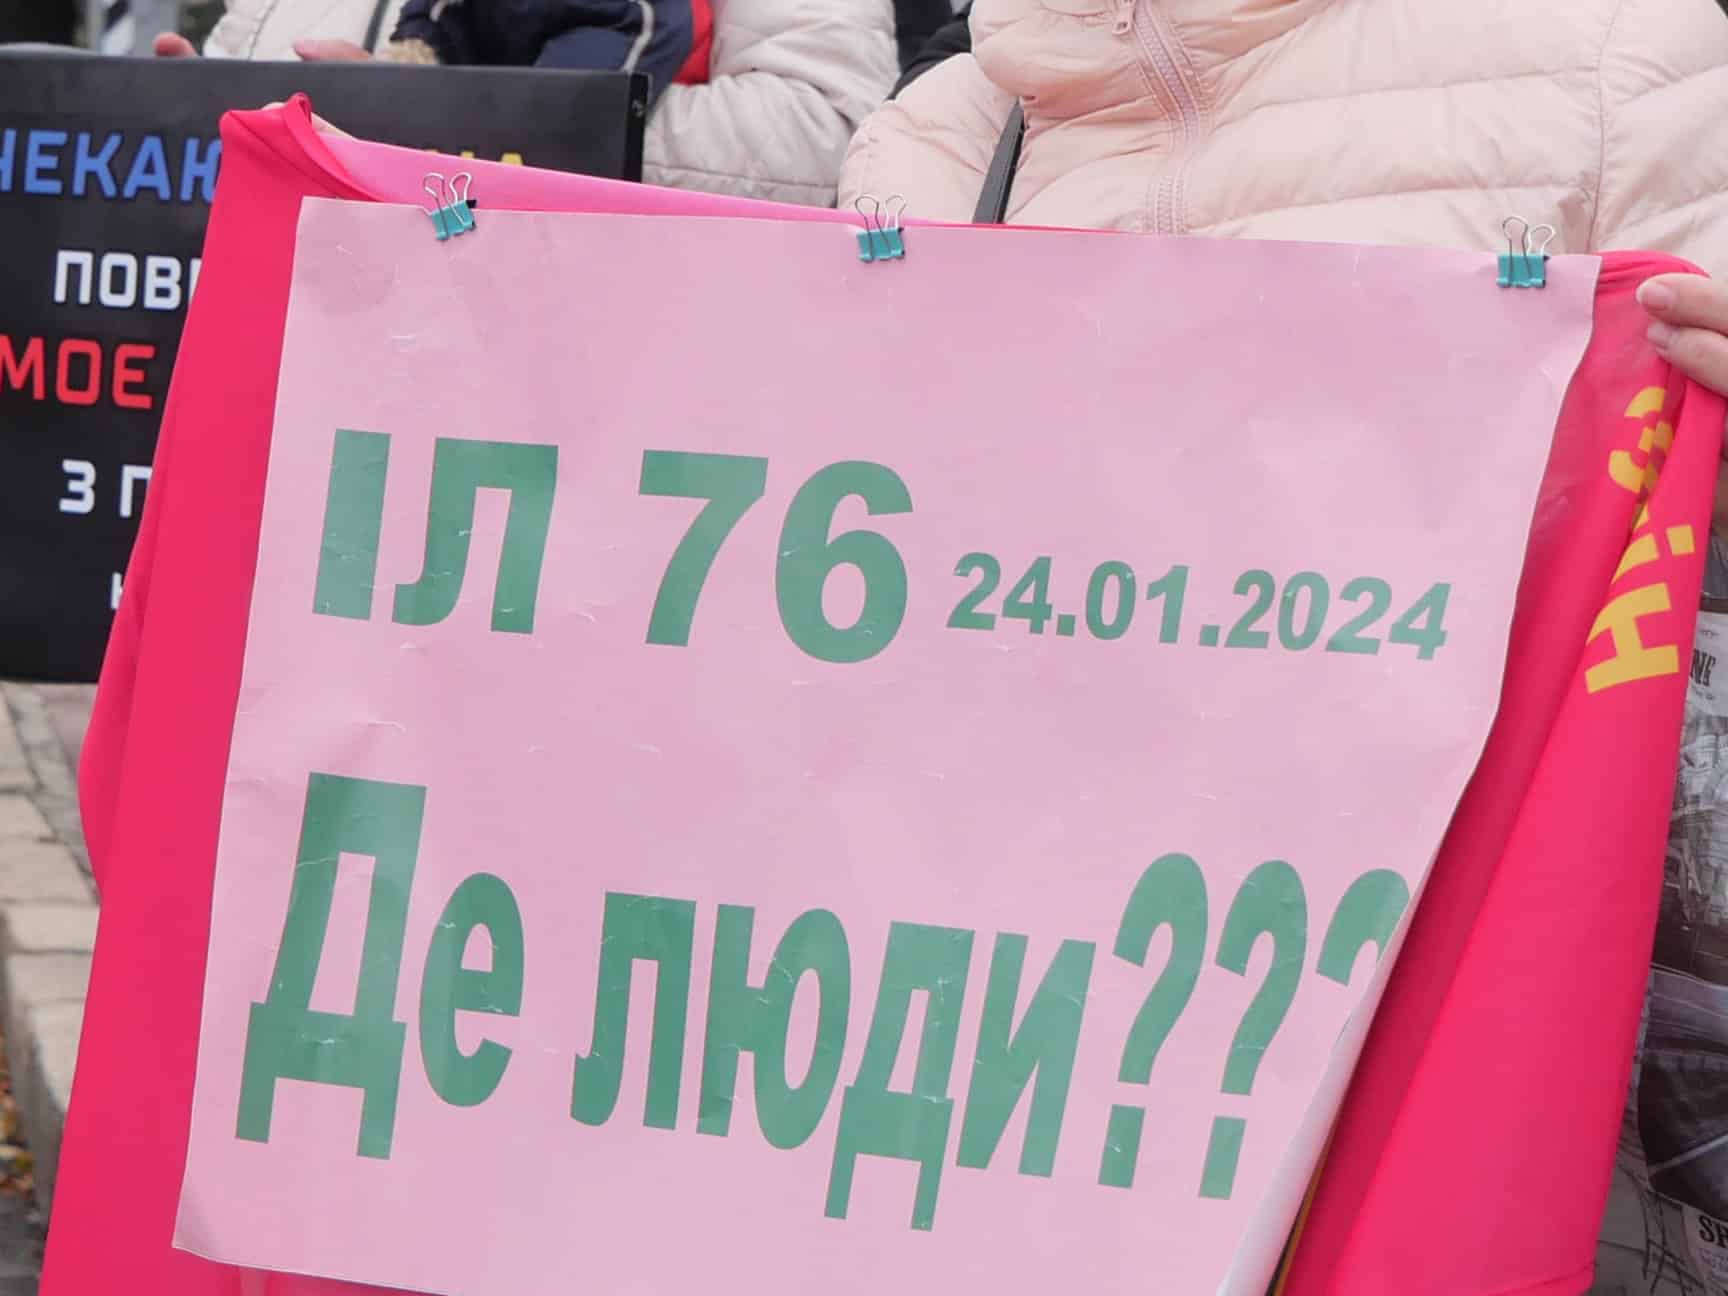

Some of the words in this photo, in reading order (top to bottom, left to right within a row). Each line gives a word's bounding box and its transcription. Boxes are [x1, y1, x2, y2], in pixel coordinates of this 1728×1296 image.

[53, 249, 203, 310] ПОВ
[311, 428, 559, 635] ІЛ
[637, 448, 915, 664] 76
[946, 550, 1455, 661] 24.01.2024
[233, 772, 526, 1161] Де
